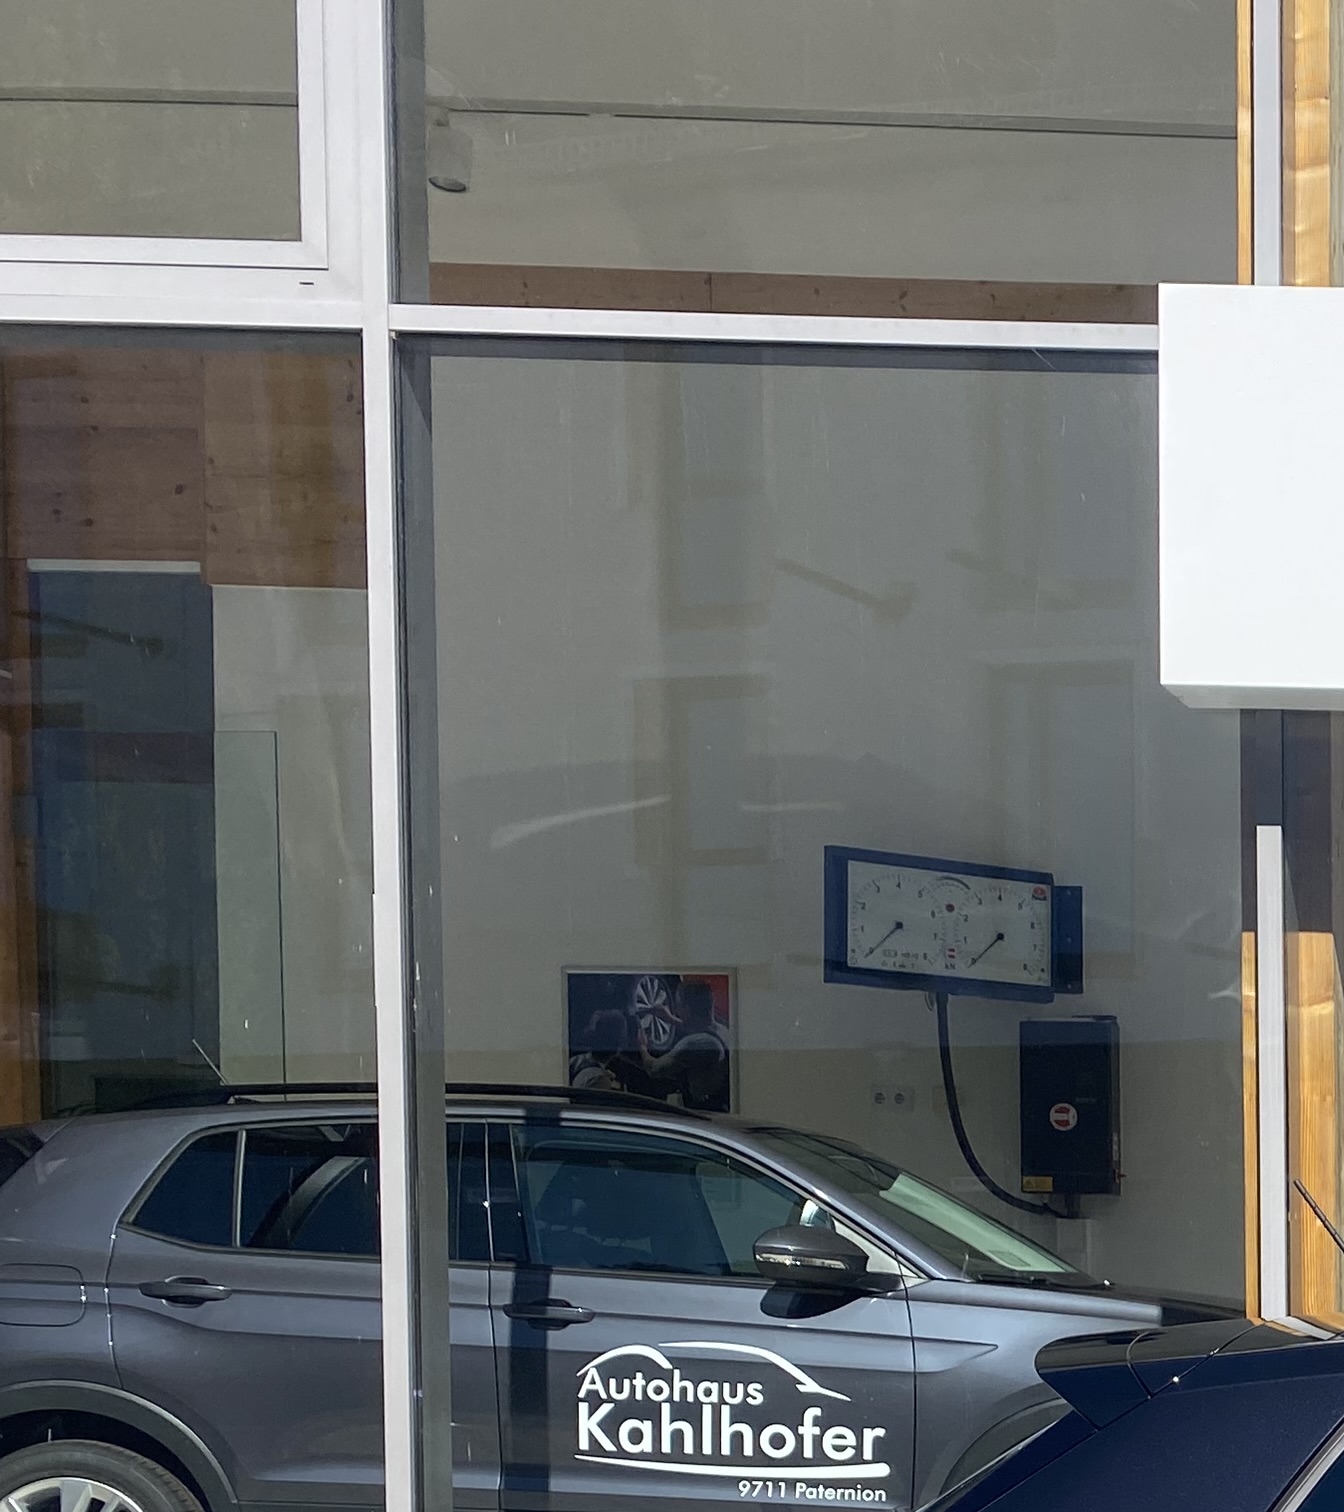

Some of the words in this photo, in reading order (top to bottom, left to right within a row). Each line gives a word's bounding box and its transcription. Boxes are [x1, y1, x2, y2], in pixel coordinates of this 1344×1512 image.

[577, 1367, 764, 1405] Autohaus
[577, 1401, 886, 1460] Kahlhofer
[738, 1480, 788, 1498] 9711
[795, 1482, 887, 1502] Paternion
